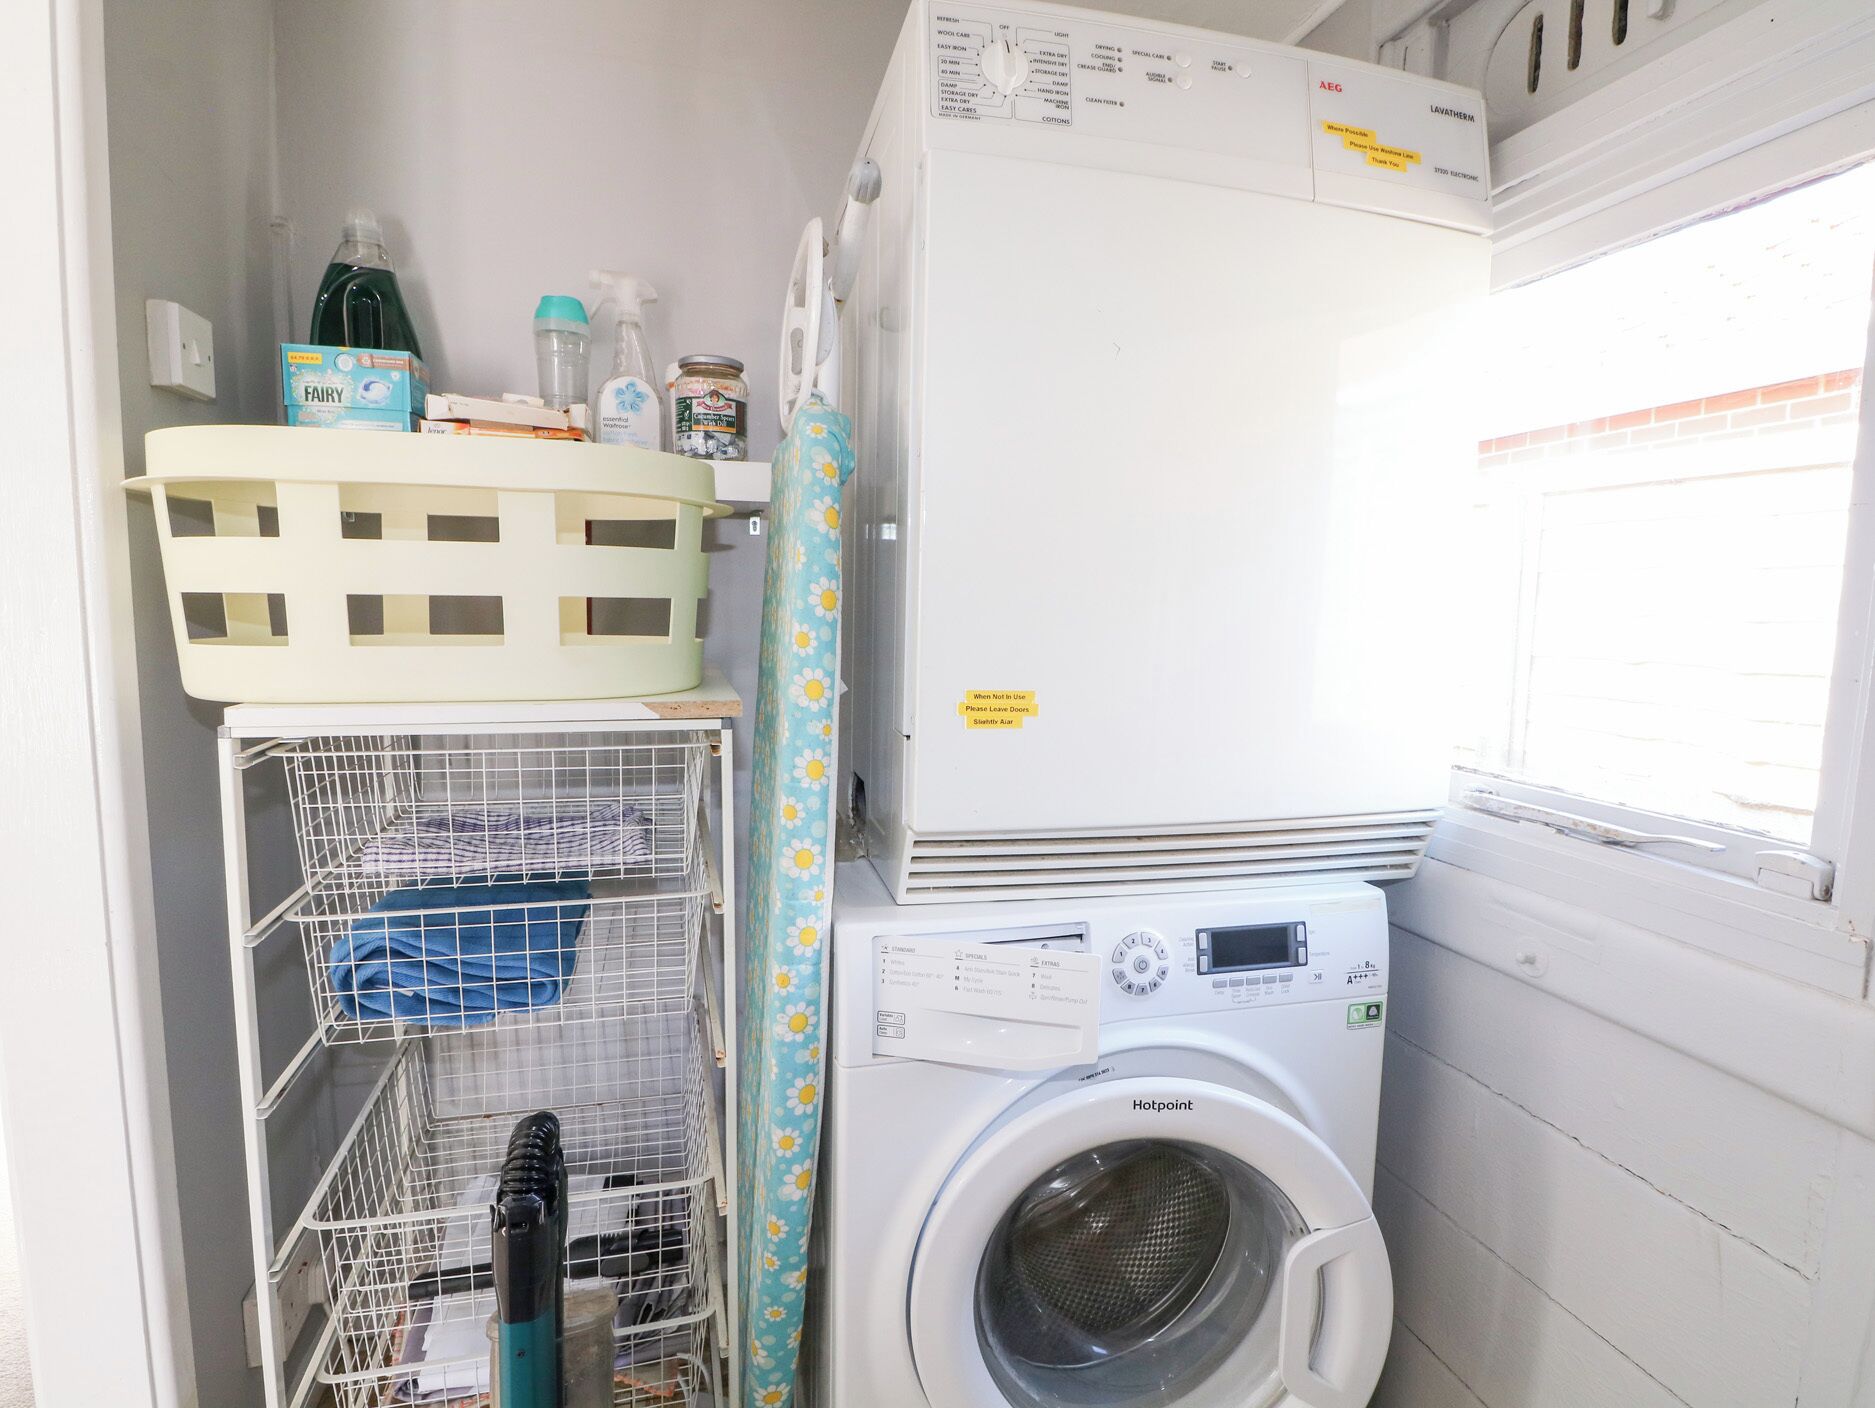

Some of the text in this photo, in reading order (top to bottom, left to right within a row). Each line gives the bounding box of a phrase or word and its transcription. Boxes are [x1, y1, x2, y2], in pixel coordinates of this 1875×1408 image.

[1319, 81, 1343, 93] AEG
[1430, 105, 1475, 122] LAVATHERM
[1042, 116, 1070, 124] COTTONS
[1327, 124, 1369, 137] Where Possible
[1349, 140, 1368, 150] Please
[1368, 144, 1379, 152] Use
[1371, 156, 1400, 168] Thank You
[1450, 171, 1479, 182] ELECTRONIC
[304, 385, 345, 403] FAIRY
[891, 946, 916, 954] STANDARD
[965, 953, 988, 961] SPECIALS
[1041, 960, 1060, 968] EXTRAS
[1365, 960, 1370, 969] 8
[1133, 1099, 1194, 1113] Hotpoint
